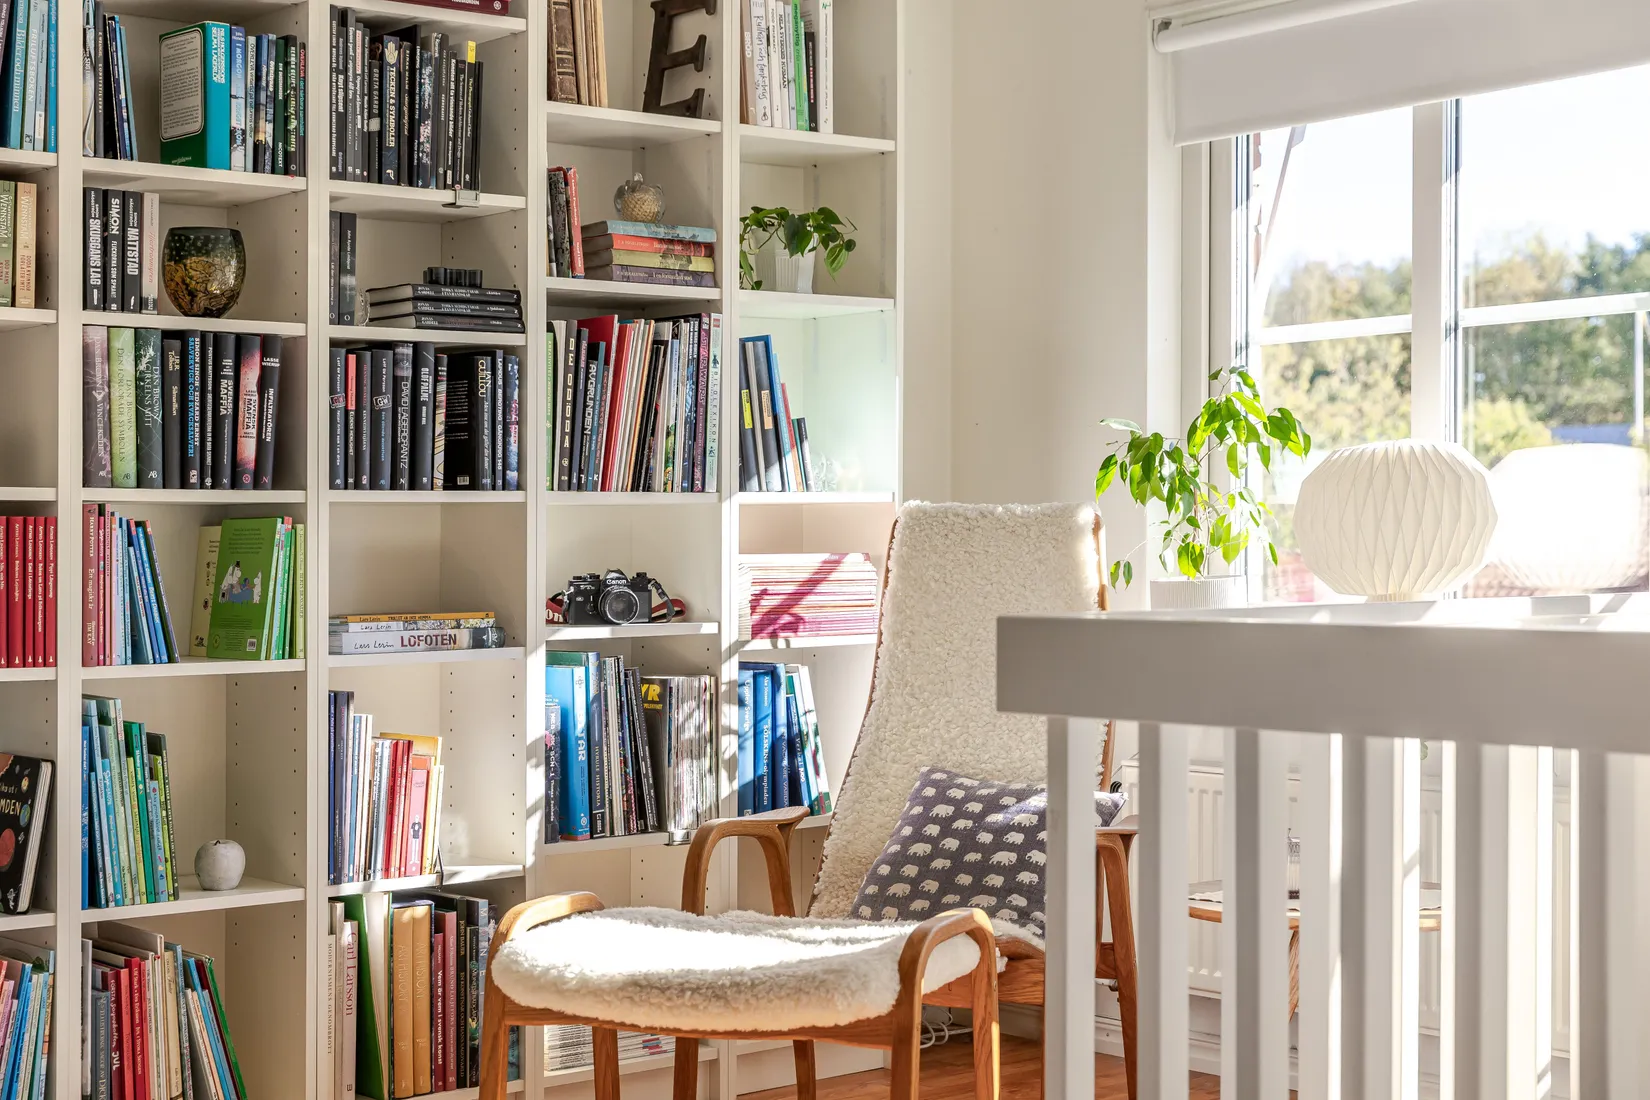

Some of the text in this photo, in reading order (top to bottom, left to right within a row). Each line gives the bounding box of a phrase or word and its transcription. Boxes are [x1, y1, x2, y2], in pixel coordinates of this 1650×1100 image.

[28, 28, 37, 102] FRILUFTSBOKEN
[109, 198, 120, 234] SIMON
[89, 218, 101, 285] SKUGGANS LAG
[127, 228, 139, 275] NATTSTAD
[219, 379, 228, 416] MAFFIA
[420, 367, 429, 401] OLOF PALME
[478, 360, 486, 397] GUILLOU
[583, 364, 597, 434] AVGRUNDEN
[266, 388, 274, 442] INFILTRATÖREN
[400, 381, 409, 469] DAVID LAGERCRANTZ
[400, 633, 457, 648] LOFOTEN
[345, 932, 357, 1016] Carl Larsson
[112, 1051, 120, 1071] JUL
